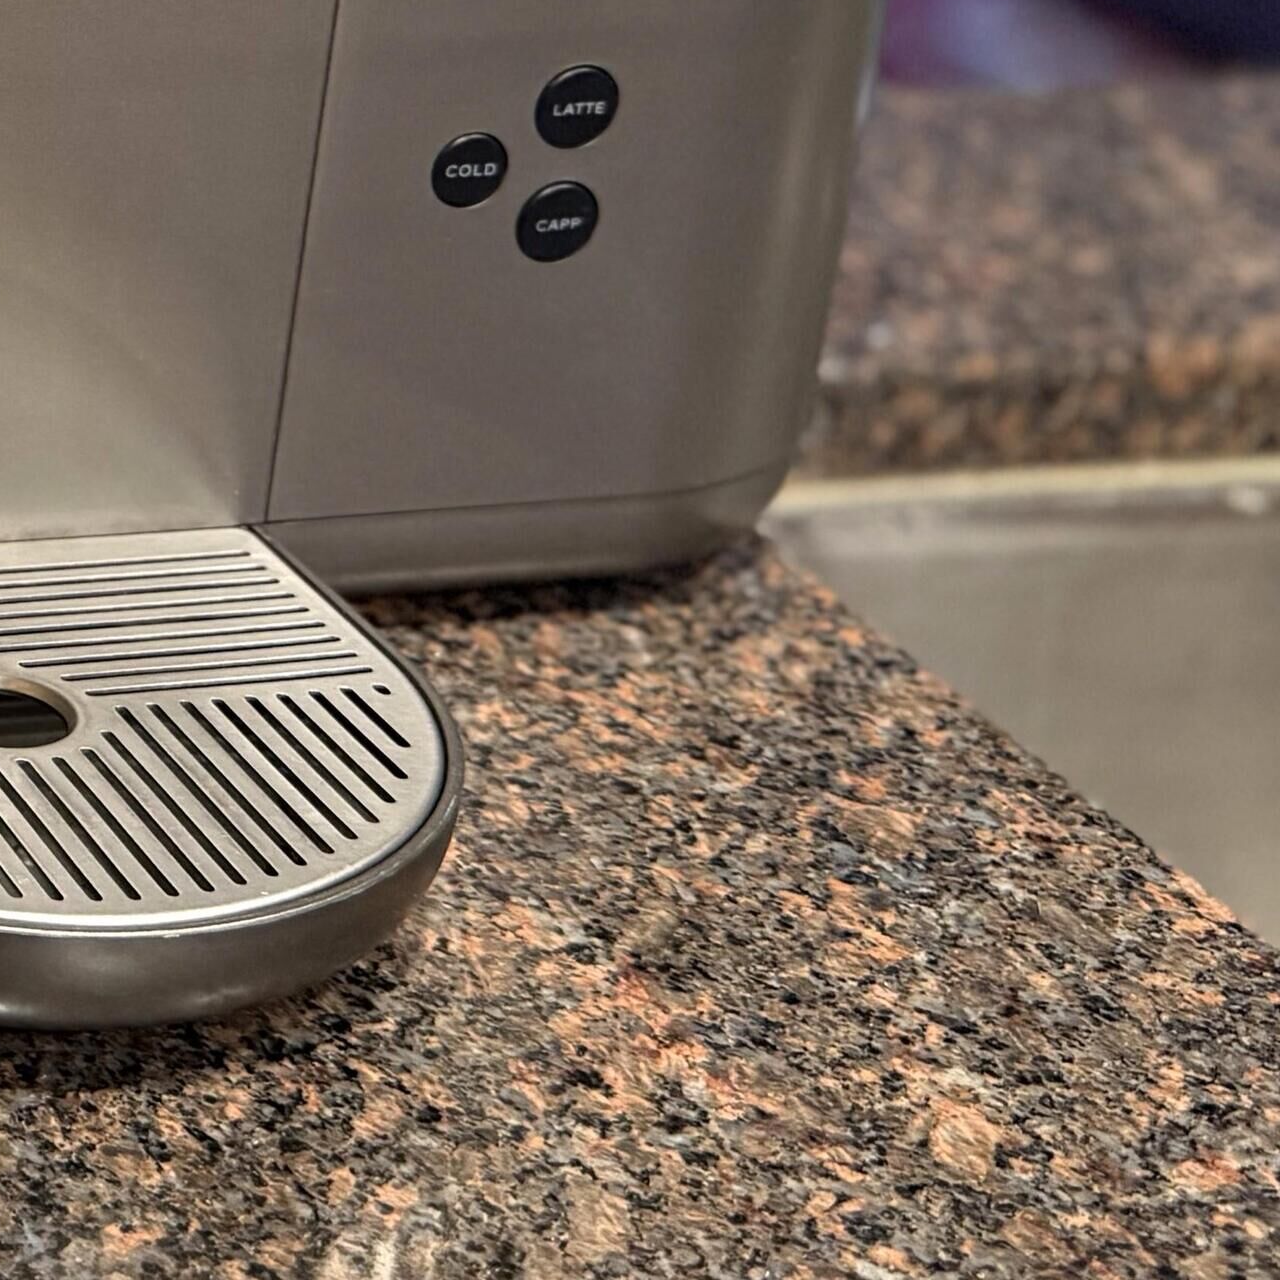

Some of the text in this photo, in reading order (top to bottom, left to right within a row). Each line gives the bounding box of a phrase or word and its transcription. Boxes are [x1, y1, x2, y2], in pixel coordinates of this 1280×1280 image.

[552, 101, 608, 117] LATTE
[444, 162, 498, 178] COLD
[535, 217, 582, 232] CAPP
